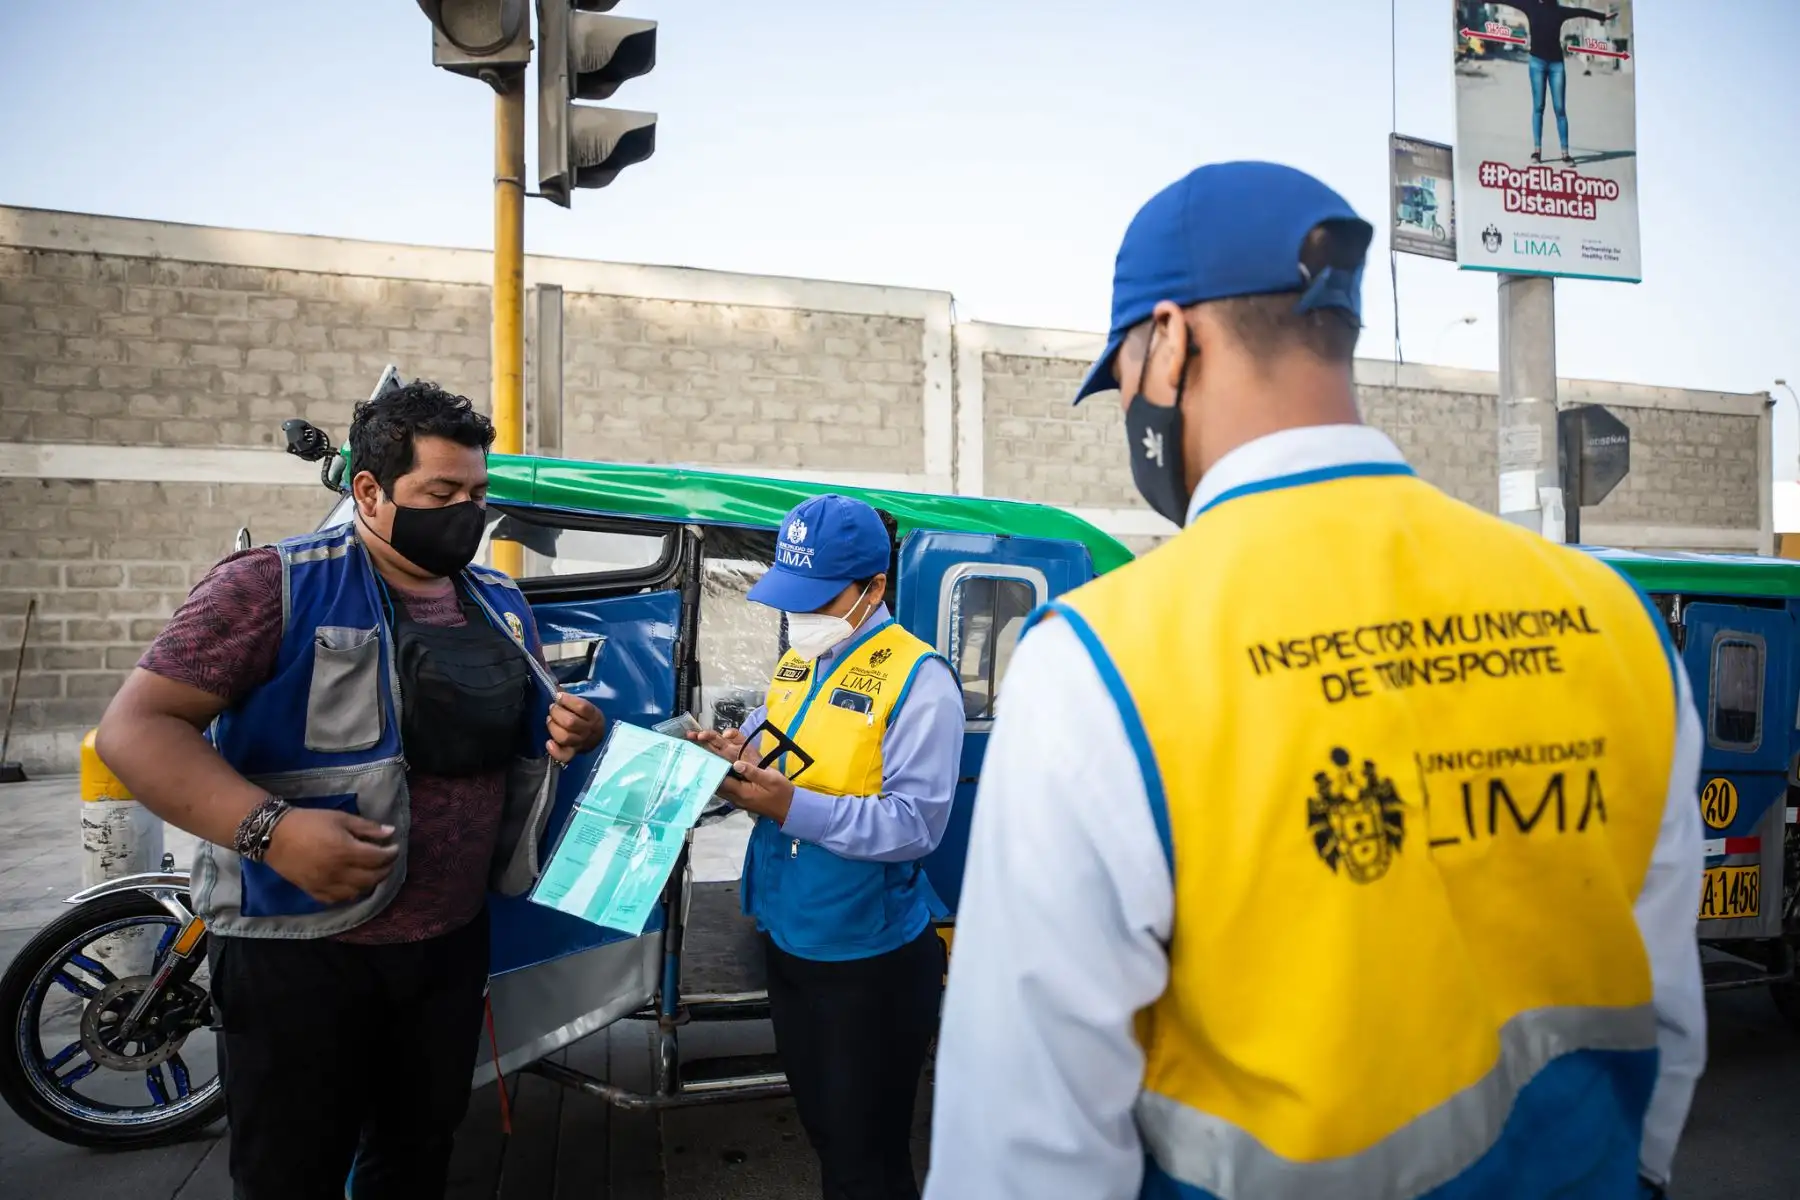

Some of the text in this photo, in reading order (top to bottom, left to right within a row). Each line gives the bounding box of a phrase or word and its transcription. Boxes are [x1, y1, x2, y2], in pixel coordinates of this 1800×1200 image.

[1481, 162, 1619, 200] #PorEllaTomo
[1505, 189, 1596, 219] Distancia
[1513, 239, 1562, 258] LIMA
[777, 549, 813, 569] LIMA
[1247, 605, 1601, 676] INSPECTOR MUNICIPAL
[839, 674, 883, 695] LIMA
[1320, 666, 1372, 704] DE
[1703, 782, 1731, 823] 20
